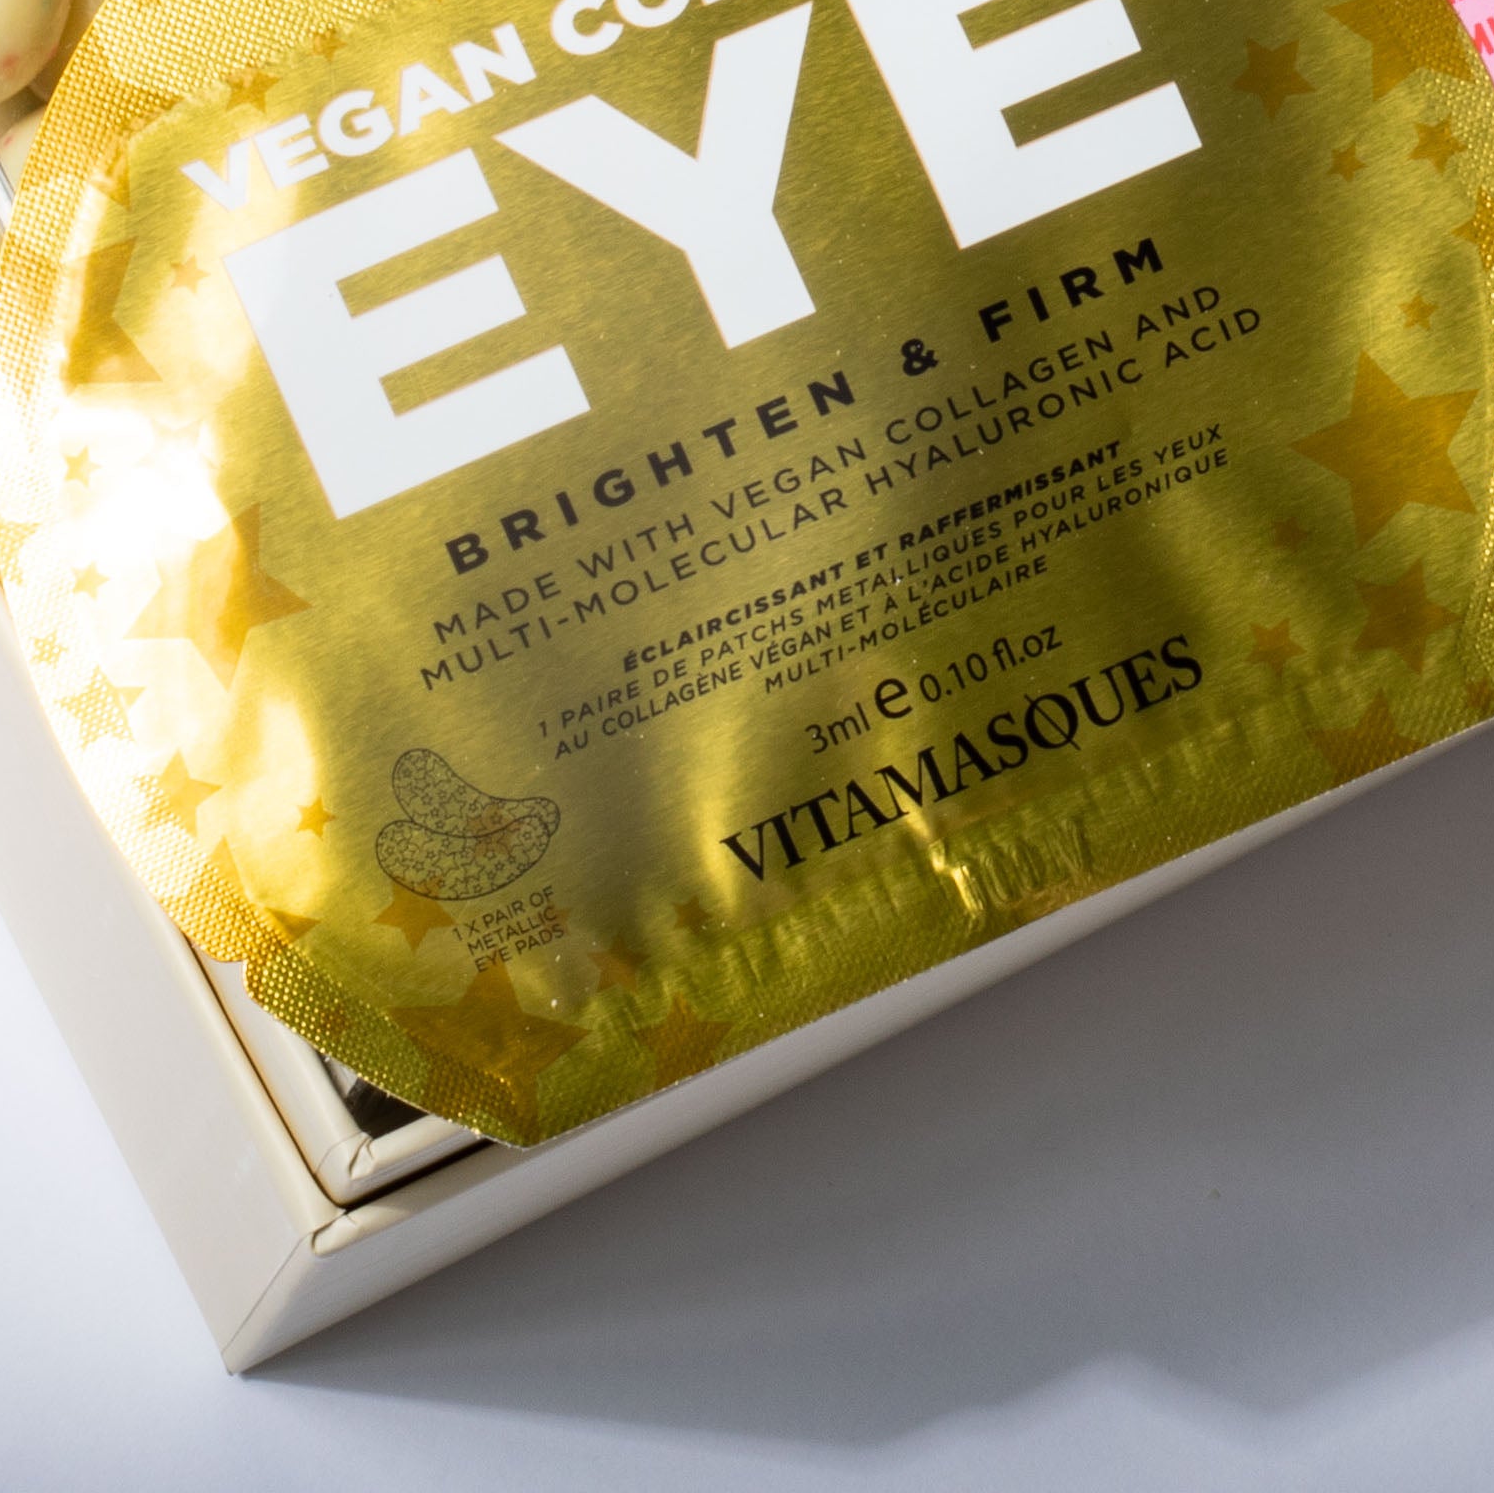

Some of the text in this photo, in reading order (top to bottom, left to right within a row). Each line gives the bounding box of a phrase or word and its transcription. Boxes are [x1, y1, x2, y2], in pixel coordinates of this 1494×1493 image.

[180, 22, 536, 214] VEGAN
[420, 307, 1261, 691] MULTI-MOLECULAR HYALURONIC ACID
[433, 286, 1220, 644] MADE WITH VEGAN COLLAGEN AND
[444, 237, 1163, 575] BRIGHTEN & FIRM
[538, 423, 1223, 738] 1 PAIRE DE PATCHS METALLIQUES POUR LES YEUX
[554, 448, 1229, 760] AU COLLAGÈNE VÉGAN ET À L'ACIDE HYALURONIQUE
[623, 440, 1121, 673] ÉCLAIRCISSANT ET RAFFERMISSANT
[764, 554, 1049, 695] MULTI-MOLÉCULAIRE
[719, 633, 1204, 882] VITAMASQUES
[804, 702, 871, 754] 3ml
[919, 653, 988, 704] 0.10
[991, 625, 1063, 671] fl.oz
[452, 927, 464, 942] 1
[482, 899, 526, 929] PAIR
[529, 885, 555, 908] OF
[467, 906, 559, 956] METALLIC
[474, 924, 565, 973] EYE PADS
